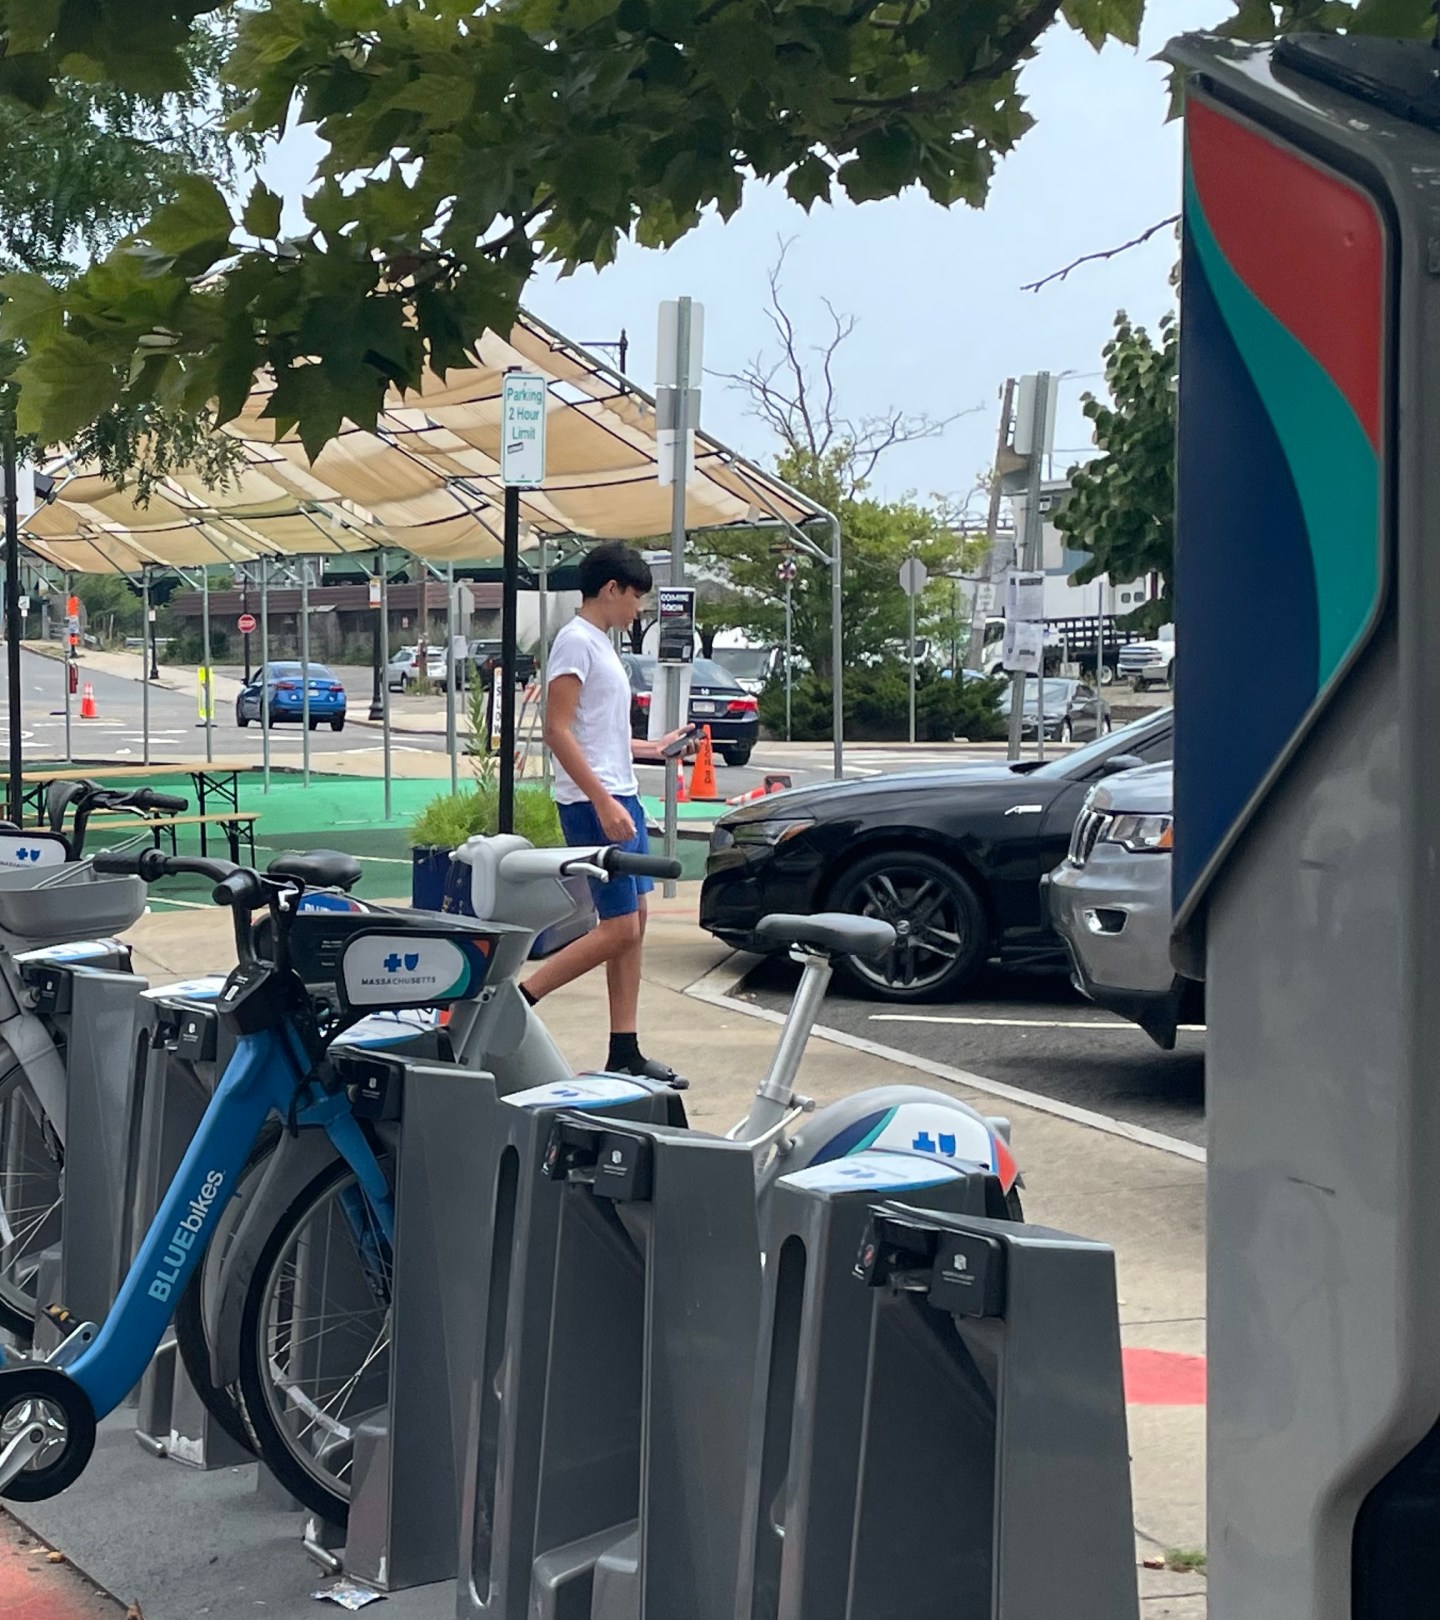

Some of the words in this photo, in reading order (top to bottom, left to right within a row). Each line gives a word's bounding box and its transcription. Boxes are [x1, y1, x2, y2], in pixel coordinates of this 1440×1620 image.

[506, 387, 542, 405] Parking
[509, 407, 514, 420] 2
[517, 407, 539, 420] Hour
[512, 426, 536, 440] Limit
[660, 593, 689, 602] COM
[361, 976, 436, 986] MASSACHUSETTS
[147, 1170, 224, 1302] BLUEbikes
